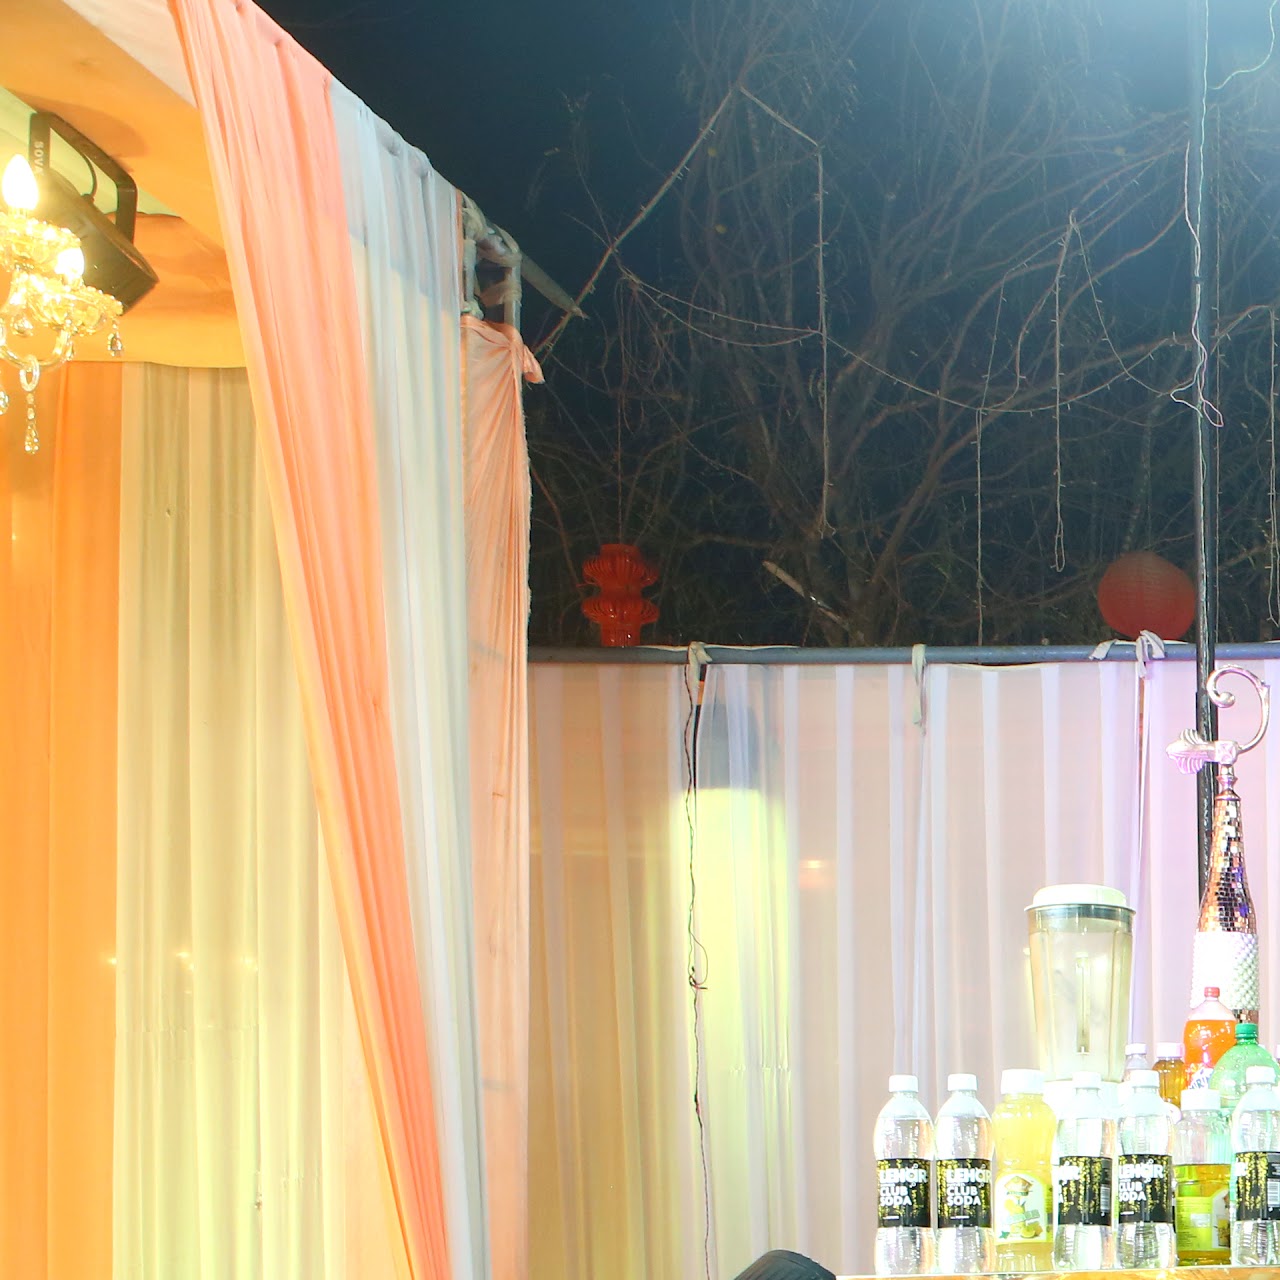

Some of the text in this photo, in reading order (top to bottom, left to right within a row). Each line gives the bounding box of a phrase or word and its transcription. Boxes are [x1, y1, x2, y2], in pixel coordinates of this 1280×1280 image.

[879, 1186, 909, 1196] CLUB
[946, 1186, 978, 1196] CLUB
[879, 1196, 913, 1206] SODA
[947, 1196, 982, 1206] SODA
